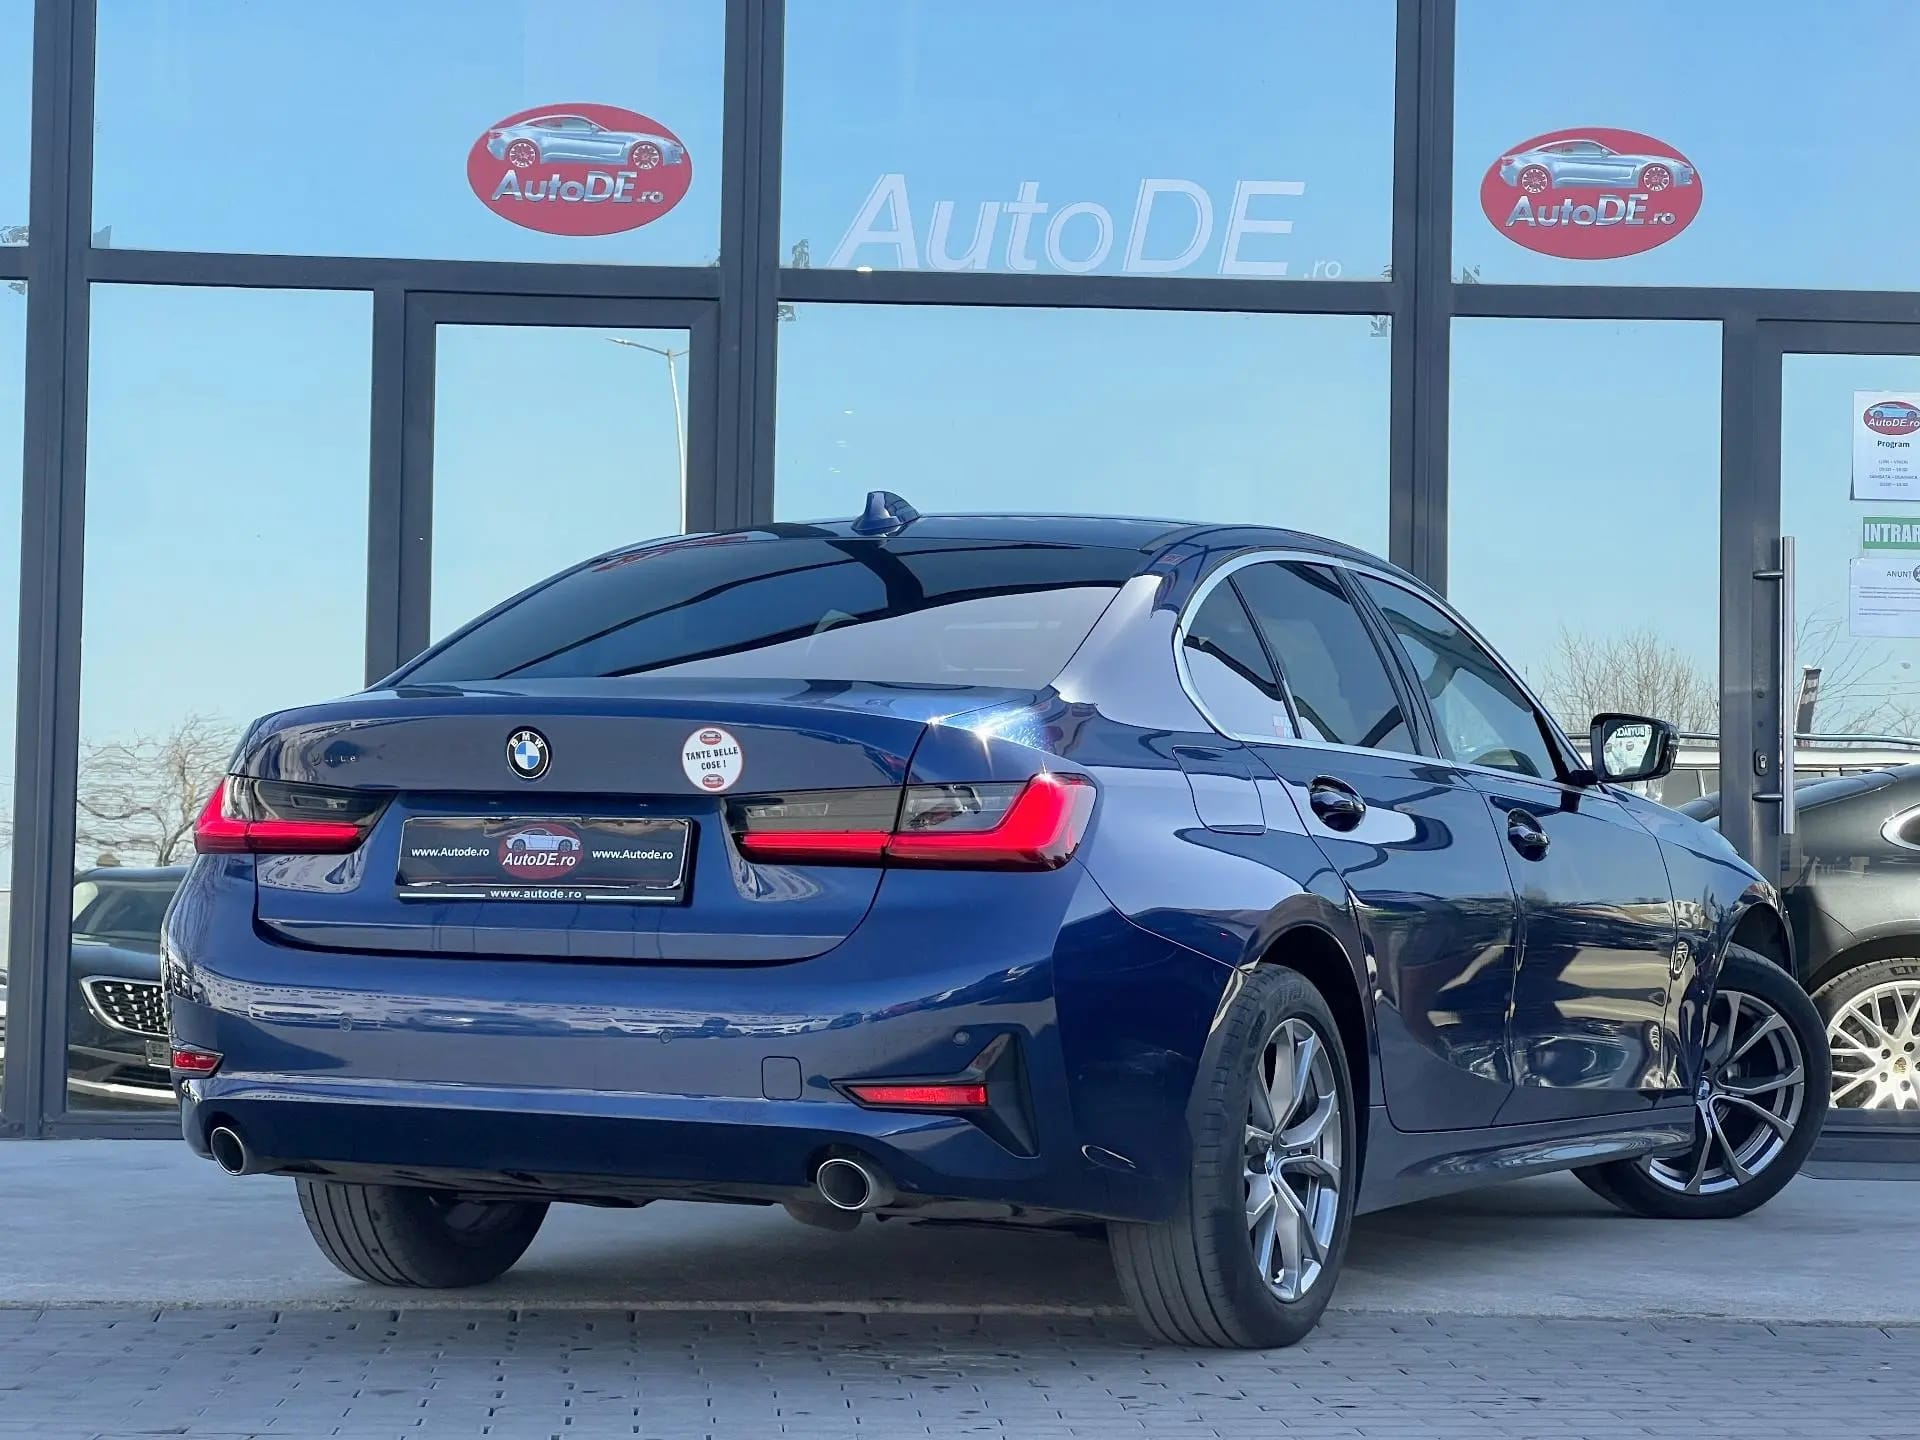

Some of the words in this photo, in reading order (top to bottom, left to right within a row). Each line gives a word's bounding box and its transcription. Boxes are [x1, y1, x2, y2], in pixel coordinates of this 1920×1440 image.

[1877, 440, 1910, 448] Program
[685, 749, 711, 760] TANTE
[713, 746, 738, 757] BELLE
[701, 760, 720, 770] COSE
[411, 847, 490, 857] www.Autode.ro
[592, 849, 674, 860] www.Autode.ro
[502, 852, 576, 867] AutoDE.ro
[490, 889, 582, 899] www.autode.ro
